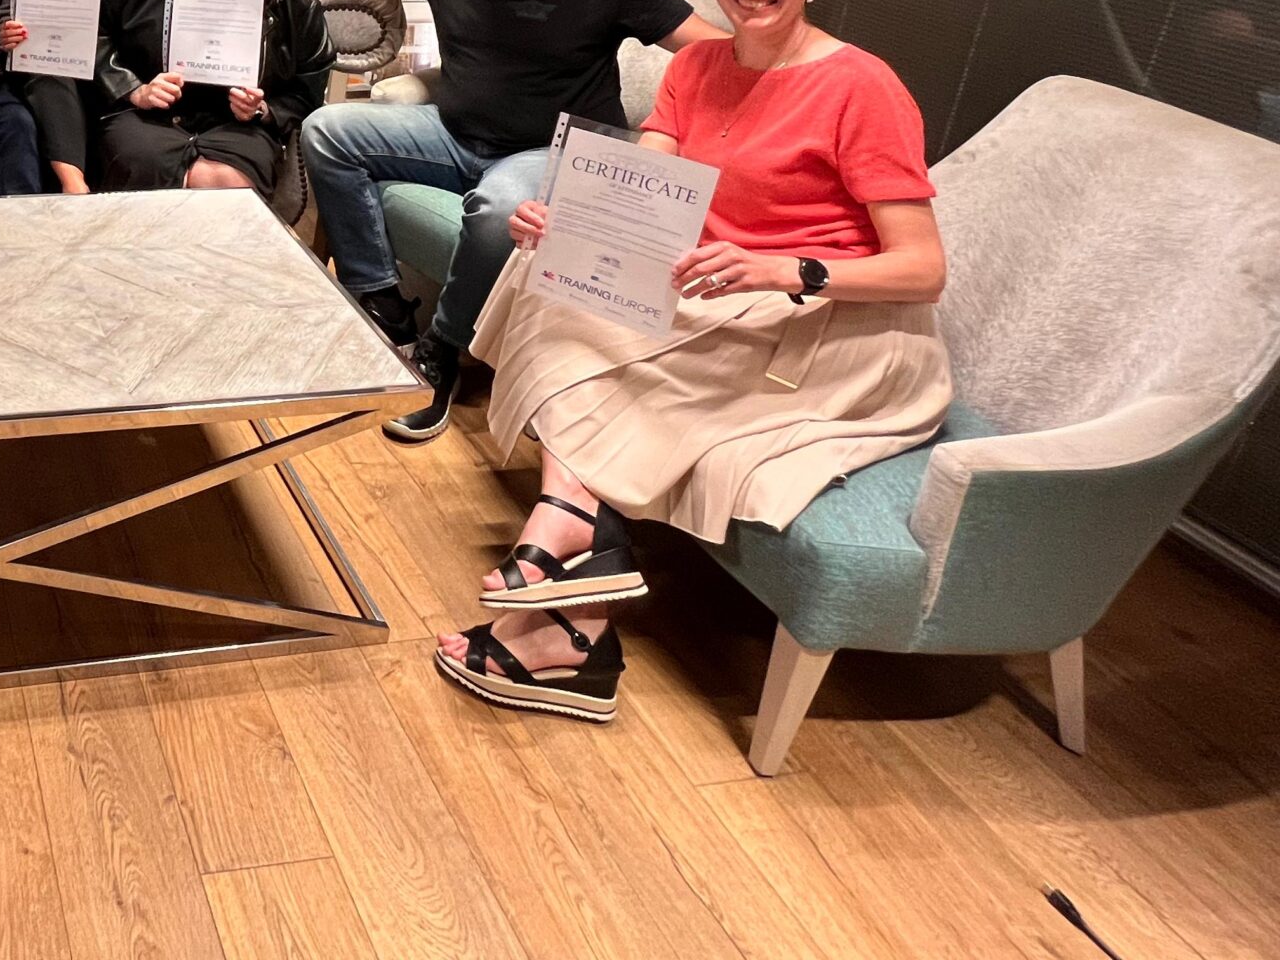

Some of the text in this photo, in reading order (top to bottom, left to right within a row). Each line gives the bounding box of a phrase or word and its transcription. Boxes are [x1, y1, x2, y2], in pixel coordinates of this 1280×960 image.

[29, 54, 88, 67] TRAINING EUROPE
[186, 60, 252, 74] TRAINING EUROPE
[572, 156, 699, 205] CERTIFICATE
[558, 274, 612, 301] TRAINING
[613, 294, 663, 319] EUROPE
